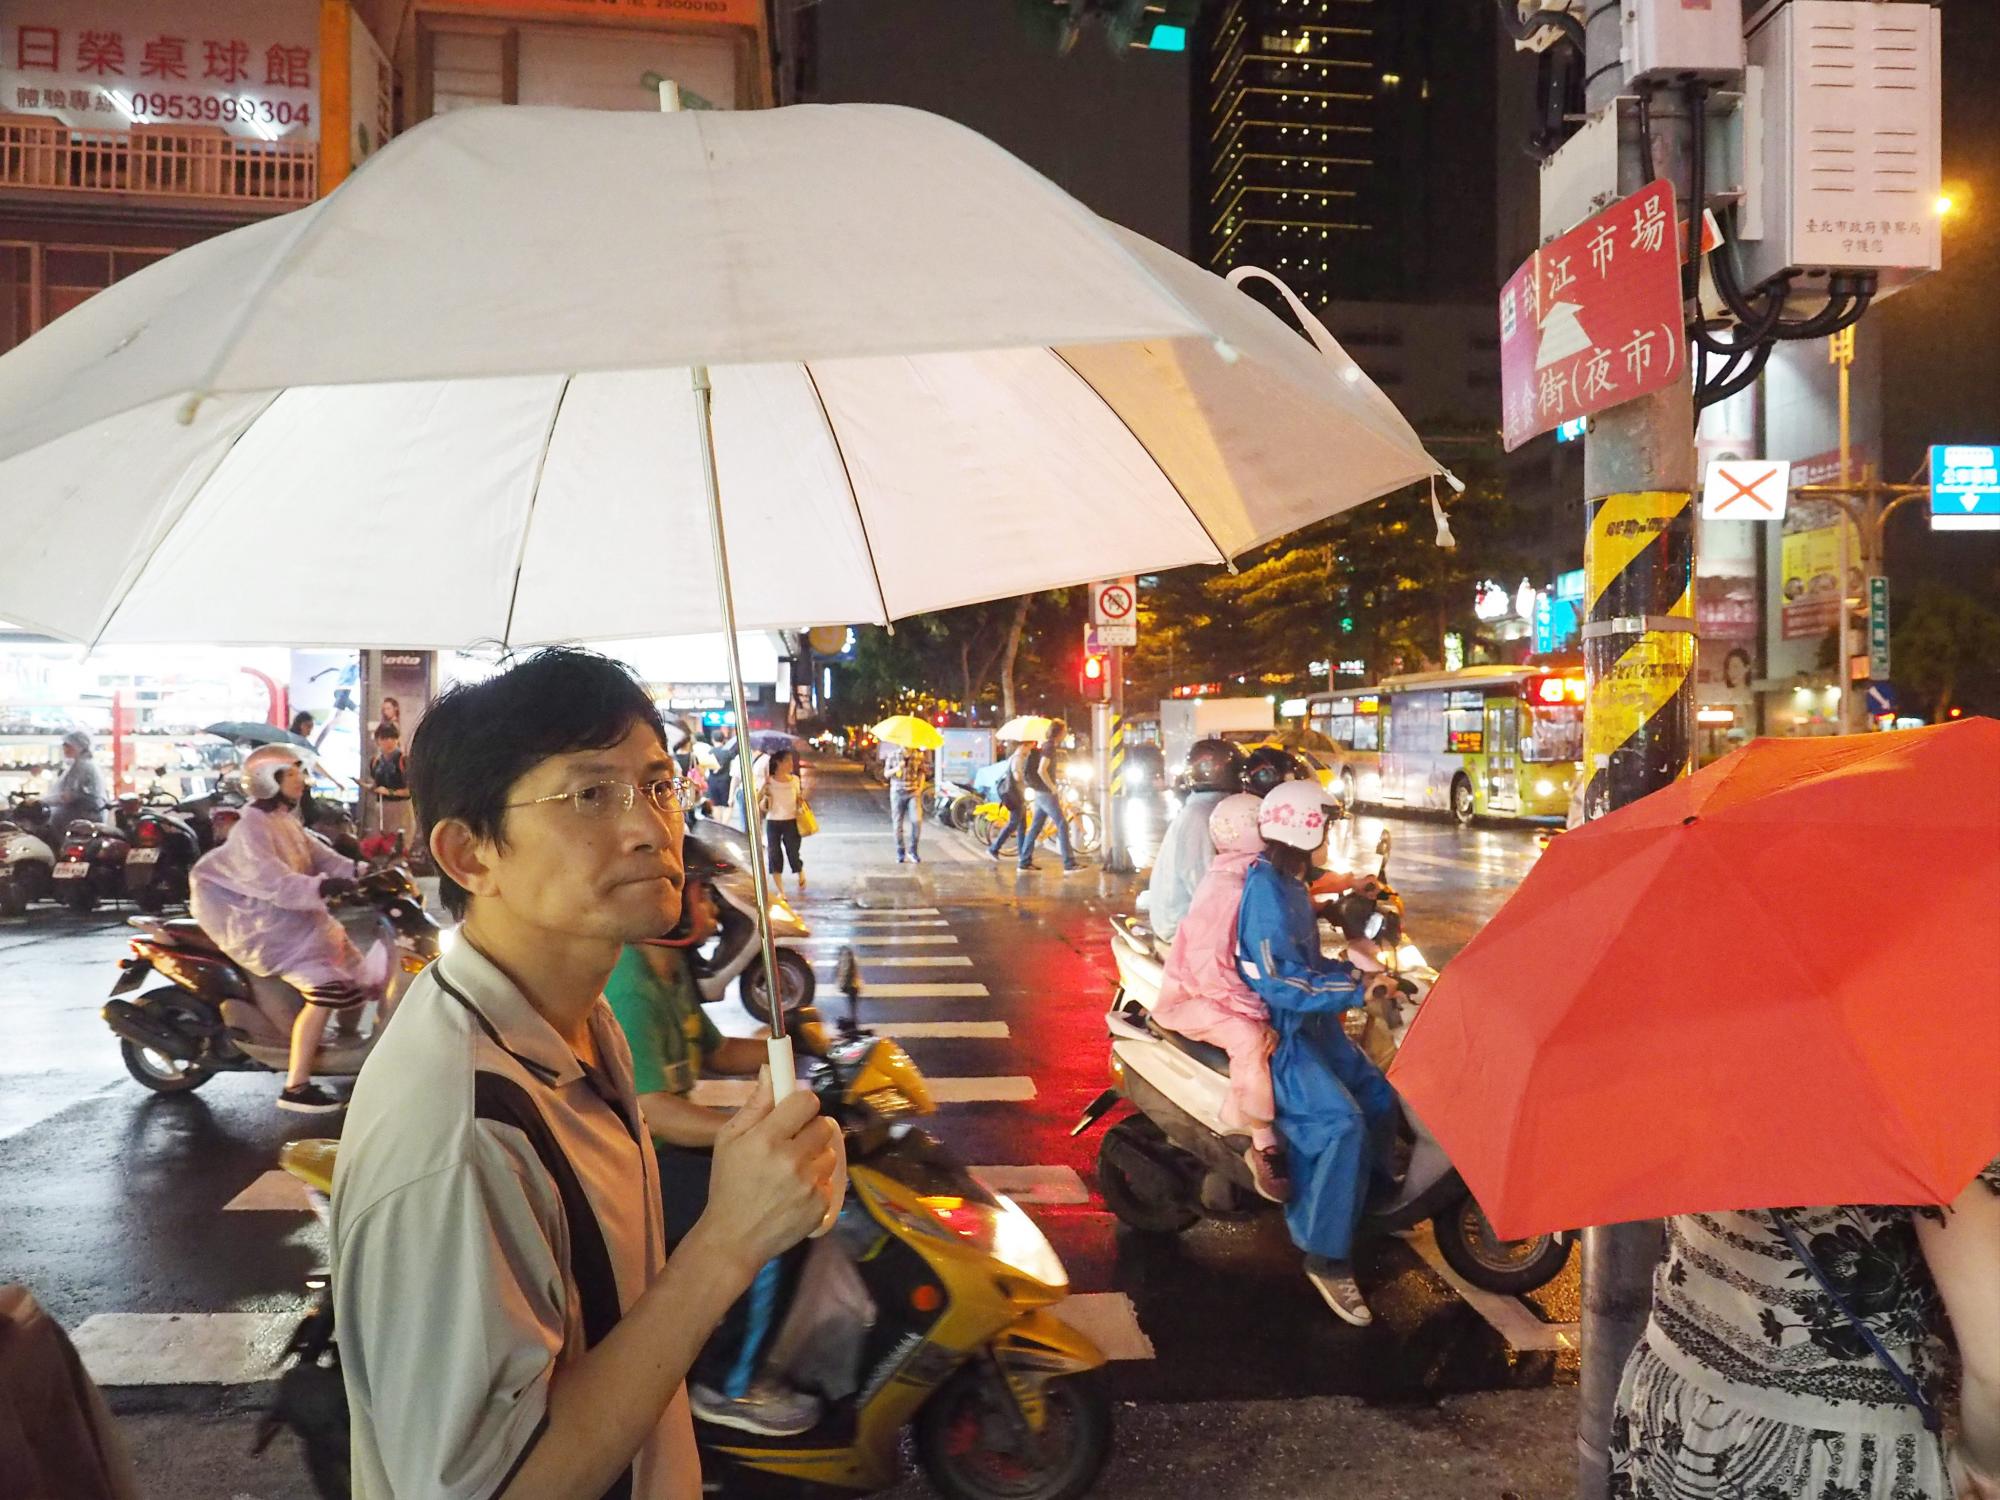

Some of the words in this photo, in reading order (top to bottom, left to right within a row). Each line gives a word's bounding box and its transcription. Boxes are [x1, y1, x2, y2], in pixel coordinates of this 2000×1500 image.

[17, 25, 311, 88] 日榮桌球館
[132, 93, 310, 126] 0953999304
[1806, 218, 1921, 235] 臺北市政府警察局
[1521, 195, 1666, 316] 松江市場
